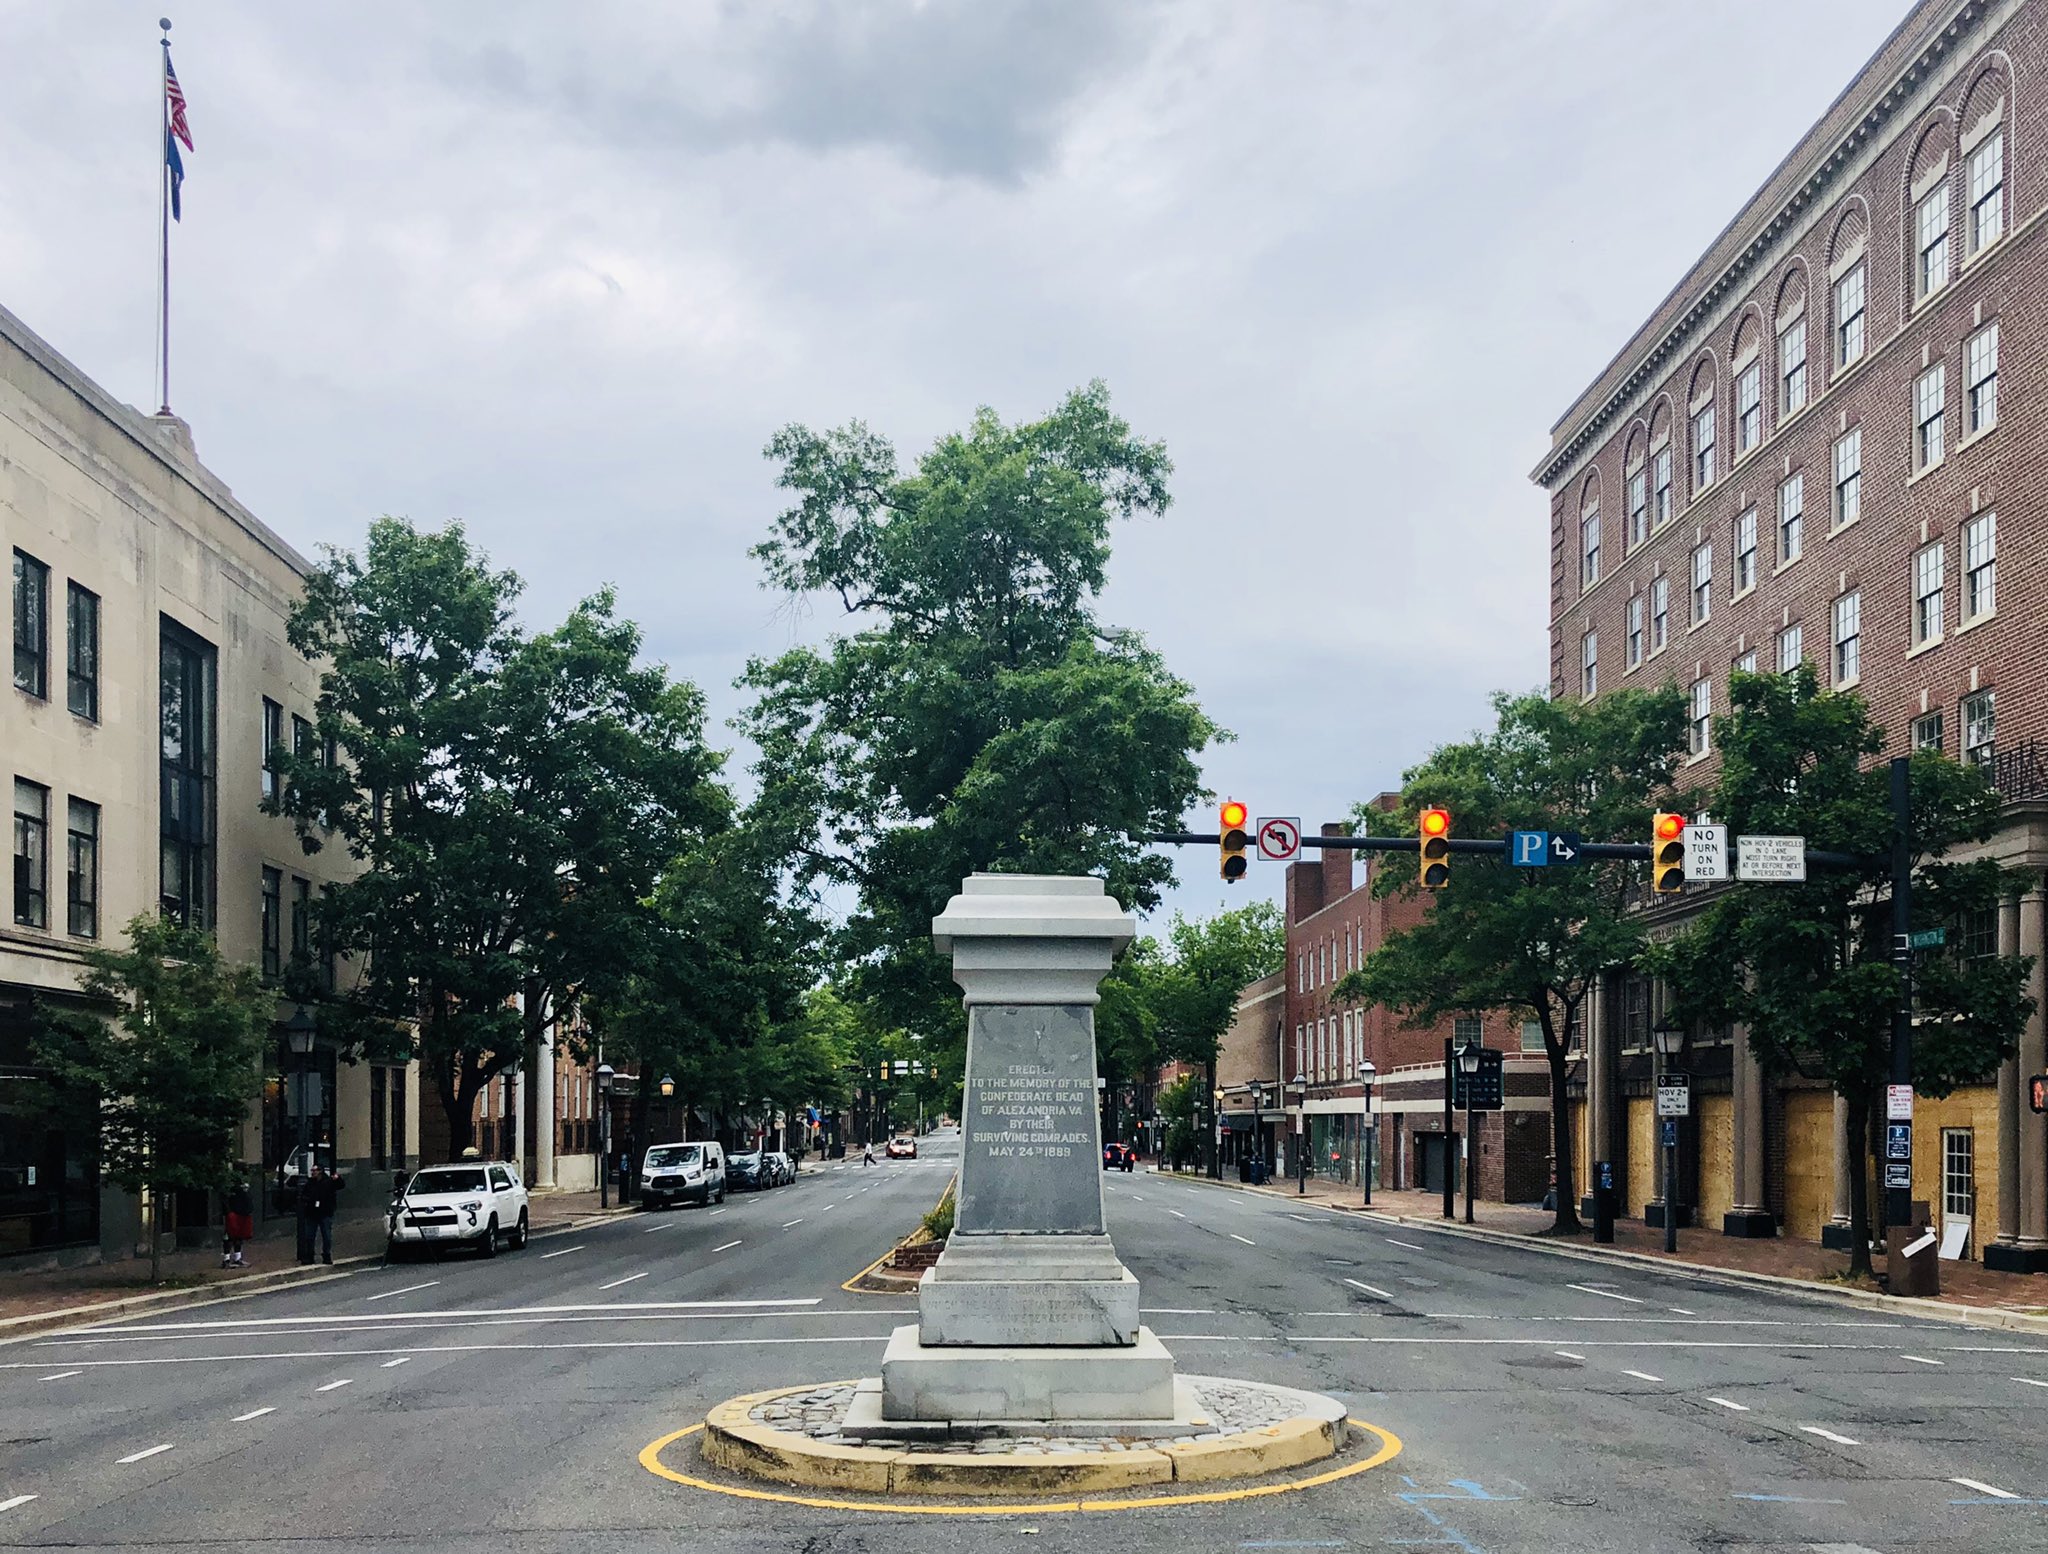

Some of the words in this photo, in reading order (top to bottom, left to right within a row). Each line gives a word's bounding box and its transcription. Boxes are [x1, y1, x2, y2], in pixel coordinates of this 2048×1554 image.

[1694, 830, 1715, 841] NO
[1518, 834, 1542, 863] P
[1692, 844, 1718, 853] TURN
[1775, 840, 1802, 848] VEHICLES
[1697, 855, 1713, 865] ON
[1695, 867, 1716, 876] RED
[1751, 869, 1792, 877] INTERSECTION
[971, 1078, 985, 1088] TO
[986, 1078, 1008, 1088] THE
[1009, 1079, 1057, 1089] MEMORY
[1058, 1079, 1072, 1089] OF
[1073, 1080, 1093, 1089] THE
[980, 1091, 1053, 1102] CONFEDERATE
[1055, 1092, 1084, 1102] DEAD
[1659, 1089, 1675, 1097] HOV
[981, 1105, 995, 1116] OF
[997, 1106, 1067, 1116] ALEXANDRIA
[1069, 1106, 1083, 1116] VA
[1009, 1119, 1025, 1129] BY
[1026, 1119, 1055, 1130] THEIR
[973, 1132, 1029, 1143] SURVIVING
[1895, 1127, 1903, 1137] P
[989, 1146, 1015, 1157] MAY
[1044, 1146, 1072, 1158] 1889
